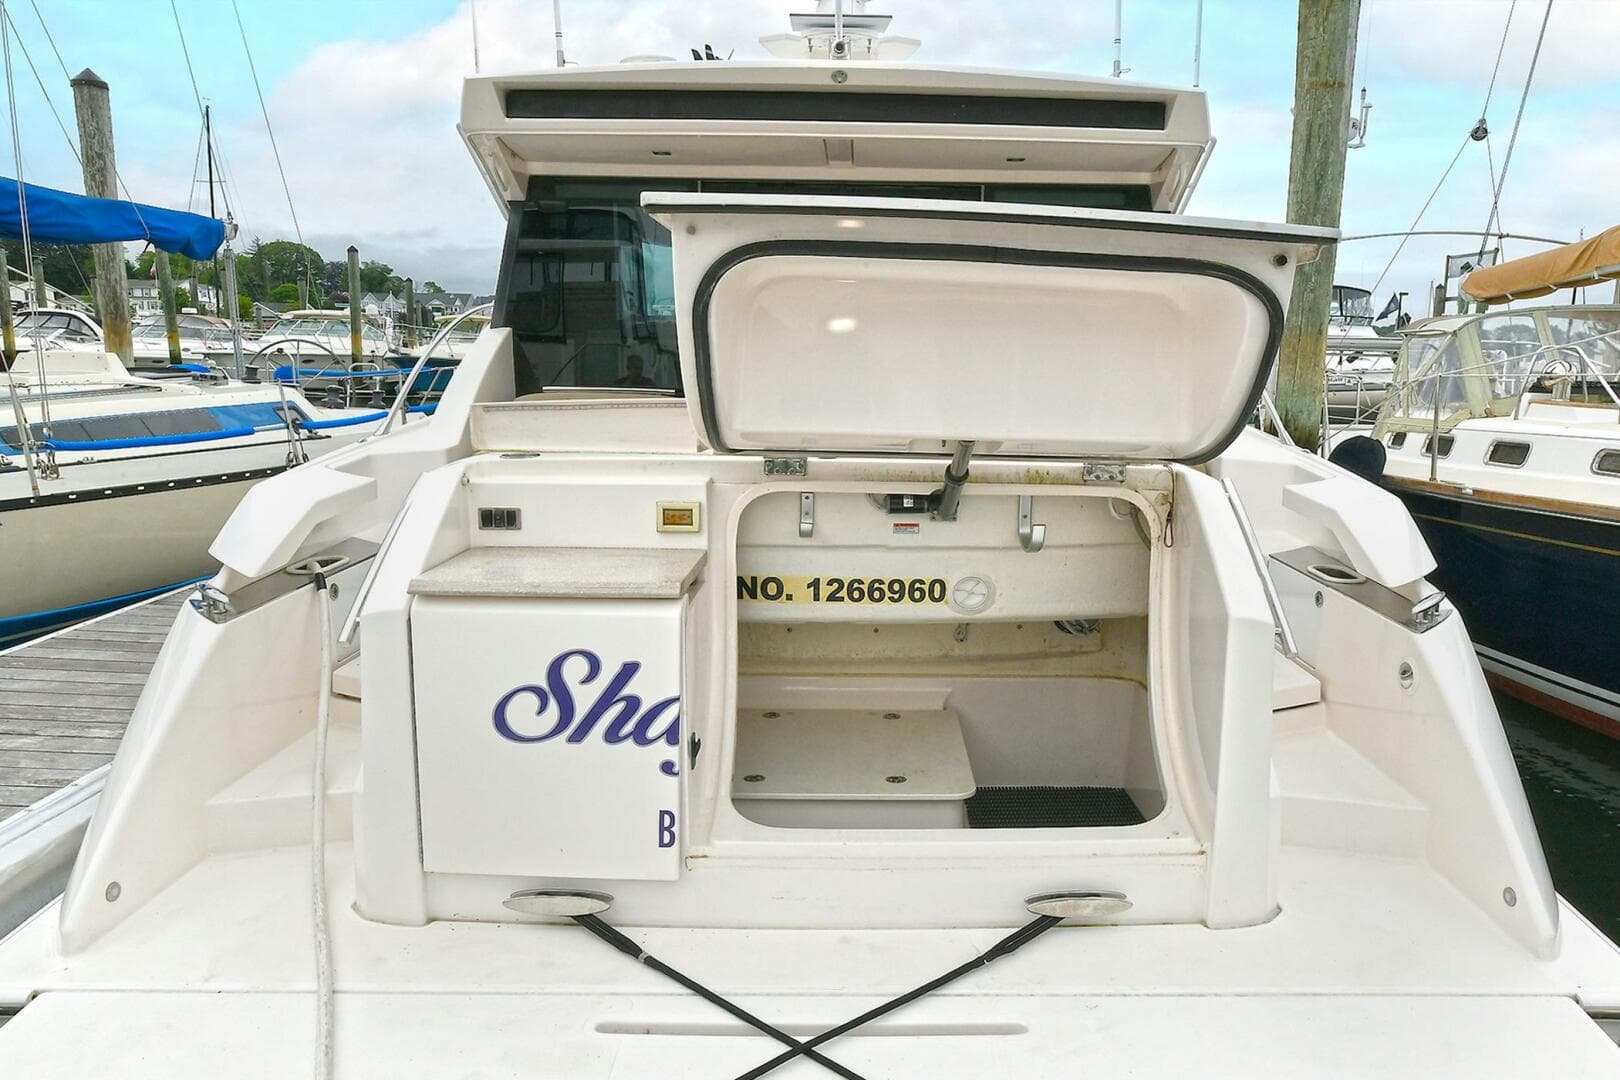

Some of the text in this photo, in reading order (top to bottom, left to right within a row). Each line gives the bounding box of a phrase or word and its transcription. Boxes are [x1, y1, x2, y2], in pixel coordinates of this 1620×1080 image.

[736, 575, 946, 603] NO. 1266960
[492, 648, 680, 777] Sha
[658, 809, 677, 848] B
